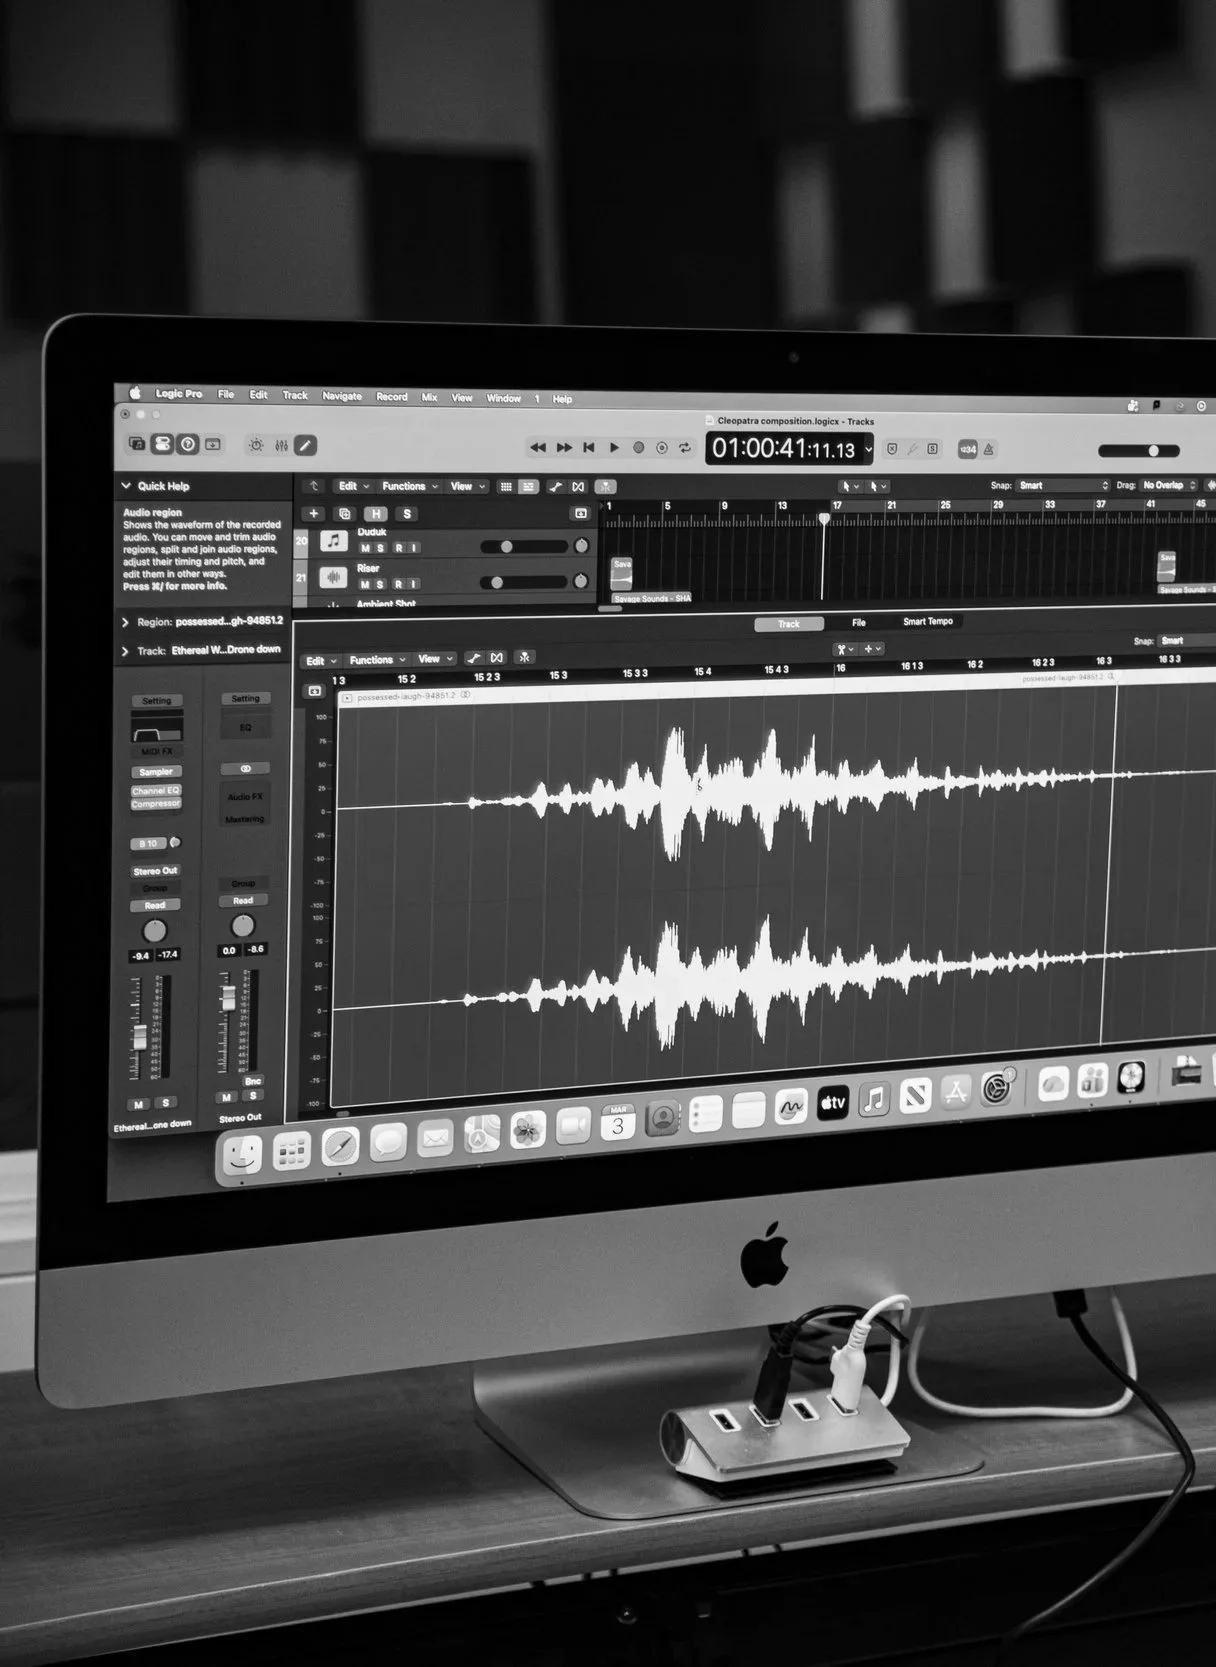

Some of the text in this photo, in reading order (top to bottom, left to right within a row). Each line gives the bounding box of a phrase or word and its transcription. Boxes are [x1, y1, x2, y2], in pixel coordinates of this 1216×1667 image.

[155, 388, 204, 400] Logic Pro
[218, 389, 235, 399] File
[249, 389, 269, 400] Edit
[282, 390, 309, 400] Track
[322, 391, 363, 403] Navigate
[376, 391, 409, 402] Record
[421, 392, 438, 402] Mix
[451, 392, 474, 402] View
[486, 393, 522, 403] Window
[552, 394, 573, 405] Help
[717, 416, 760, 426] Cleopatra
[760, 416, 840, 428] composition.logicx
[847, 417, 875, 426] Tracks
[137, 481, 190, 493] Quick Help
[339, 480, 358, 491] Edit
[382, 481, 426, 491] Functions
[450, 481, 473, 491] View
[990, 480, 1043, 491] Snap: Smart
[1116, 480, 1184, 491] Drag: No Overlap
[606, 501, 612, 511] 1
[664, 501, 671, 511] 5
[721, 501, 728, 510] 9
[777, 500, 788, 510] 13
[832, 500, 843, 510] 17
[887, 500, 897, 510] 21
[940, 500, 951, 510] 25
[993, 500, 1004, 509] 29
[1045, 499, 1056, 509] 33
[1096, 499, 1107, 509] 37
[1146, 499, 1156, 508] 41
[1195, 499, 1207, 508] 45
[123, 507, 183, 519] Audio region
[372, 509, 381, 519] H
[403, 508, 412, 519] S
[123, 520, 282, 530] Shows the waveform of the recorded
[122, 532, 277, 542] audio. You can move and trim audio
[357, 527, 387, 537] Duduk
[295, 535, 308, 546] 20
[122, 544, 278, 556] regions, split and join audio regions,
[361, 543, 403, 553] M S R
[122, 556, 266, 568] adjust their timing and pitch, and
[357, 563, 380, 573] Riser
[122, 569, 227, 580] edit them in other ways.
[295, 573, 307, 583] 21
[123, 580, 228, 591] Press for more info.
[360, 579, 403, 589] M S R
[137, 617, 173, 629] Region:
[778, 619, 801, 629] Track
[852, 618, 867, 627] File
[903, 616, 954, 627] Smart Tempo
[1133, 636, 1184, 647] Snap: Smart
[137, 646, 166, 656] Track:
[171, 645, 210, 656] Ethereal
[255, 644, 282, 654] down
[306, 656, 325, 666] Edit
[349, 655, 394, 665] Functions
[418, 654, 441, 664] View
[142, 696, 172, 706] Setting
[231, 694, 261, 704] Setting
[139, 767, 174, 777] Sampler
[132, 786, 180, 796] Channel EQ
[131, 800, 181, 809] Compressor
[147, 839, 158, 848] 10
[133, 866, 178, 876] Stereo Out
[144, 900, 166, 910] Read
[233, 896, 254, 905] Read
[158, 950, 178, 959] -17.4
[222, 946, 236, 955] 0.0
[132, 951, 150, 961] -9.4
[245, 1077, 262, 1086] Bnc
[222, 1093, 231, 1102] M
[249, 1091, 257, 1100] S
[134, 1100, 144, 1110] M
[162, 1098, 170, 1108] S
[830, 1096, 846, 1109] tv
[610, 1106, 628, 1114] MAR
[170, 1119, 192, 1128] down
[219, 1113, 262, 1124] Stereo Out
[612, 1117, 624, 1135] 3
